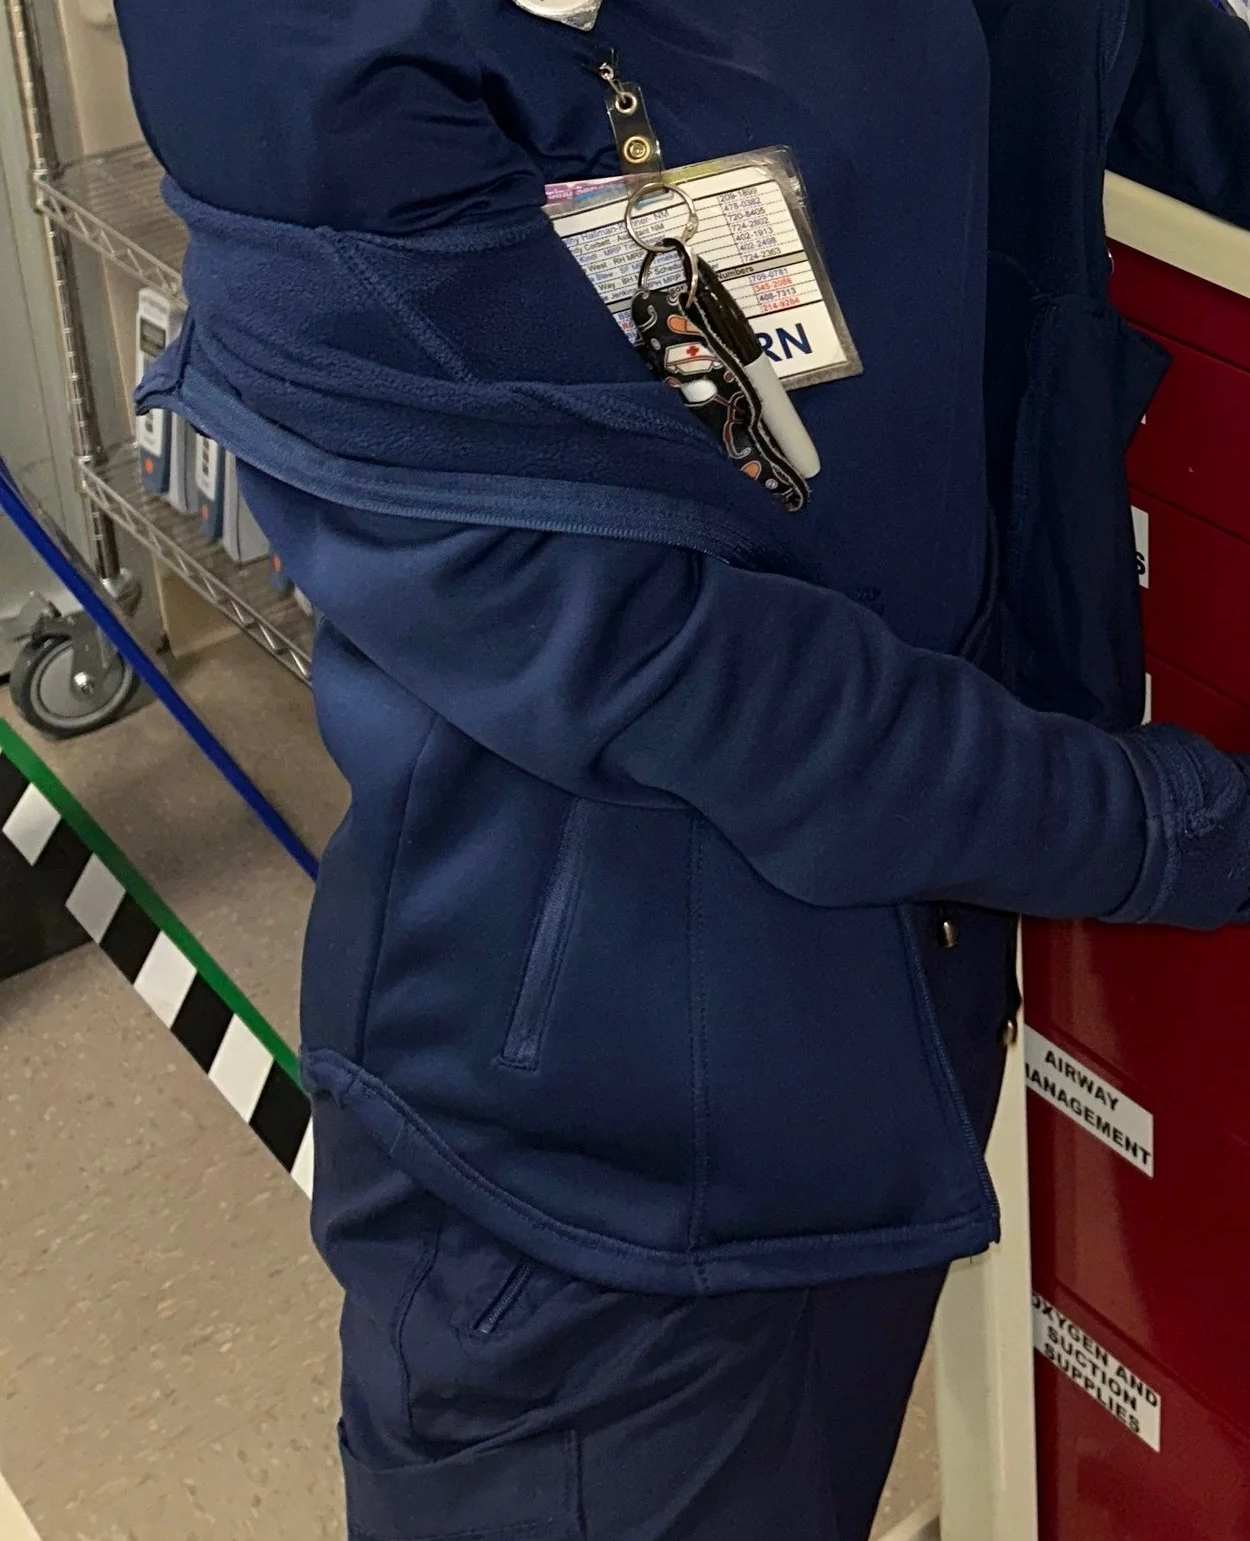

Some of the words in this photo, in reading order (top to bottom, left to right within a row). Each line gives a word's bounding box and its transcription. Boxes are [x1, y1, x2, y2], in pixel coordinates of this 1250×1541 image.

[758, 322, 813, 363] RN
[1044, 1050, 1119, 1111] AIRWAY
[1031, 1292, 1109, 1367] OXYGEN
[1116, 1366, 1158, 1408] AND
[1044, 1342, 1140, 1435] SUPPLIES
[1047, 1326, 1138, 1412] SUCTION
